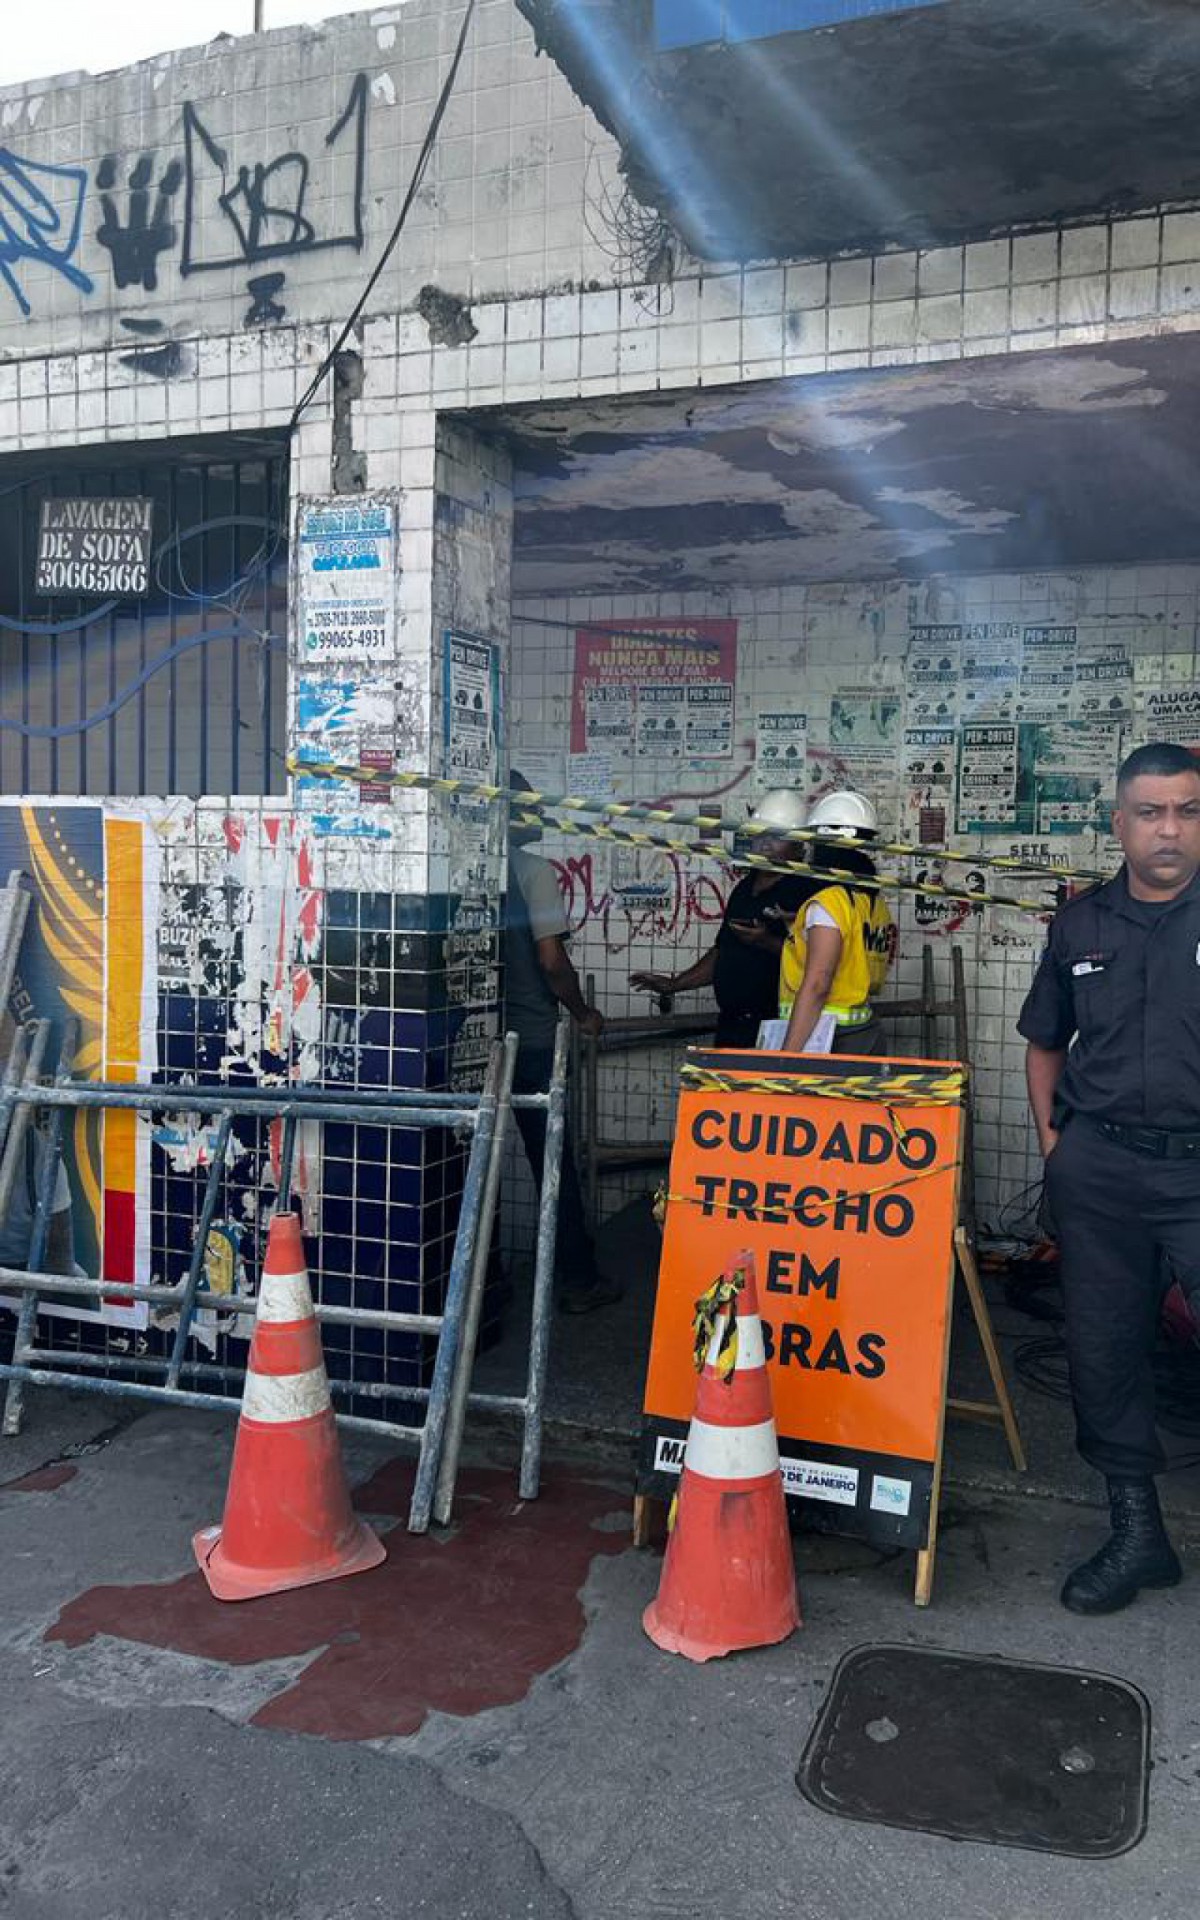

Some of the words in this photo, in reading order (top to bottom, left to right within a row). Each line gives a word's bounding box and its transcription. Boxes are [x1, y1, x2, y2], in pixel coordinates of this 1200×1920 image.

[43, 501, 151, 530] LAVAGEM
[40, 532, 72, 559] DE
[318, 629, 386, 649] 99065-4931
[588, 651, 659, 667] NUNCA
[665, 651, 721, 666] MAIS
[1147, 691, 1200, 706] ALUGA
[1153, 704, 1182, 715] UMA
[1009, 843, 1050, 856] SETE
[691, 1109, 937, 1170] CUIDADO
[695, 1175, 916, 1238] TRECHO
[766, 1250, 841, 1300] EM
[787, 1470, 803, 1484] DE
[806, 1475, 856, 1491] JANEIRO
